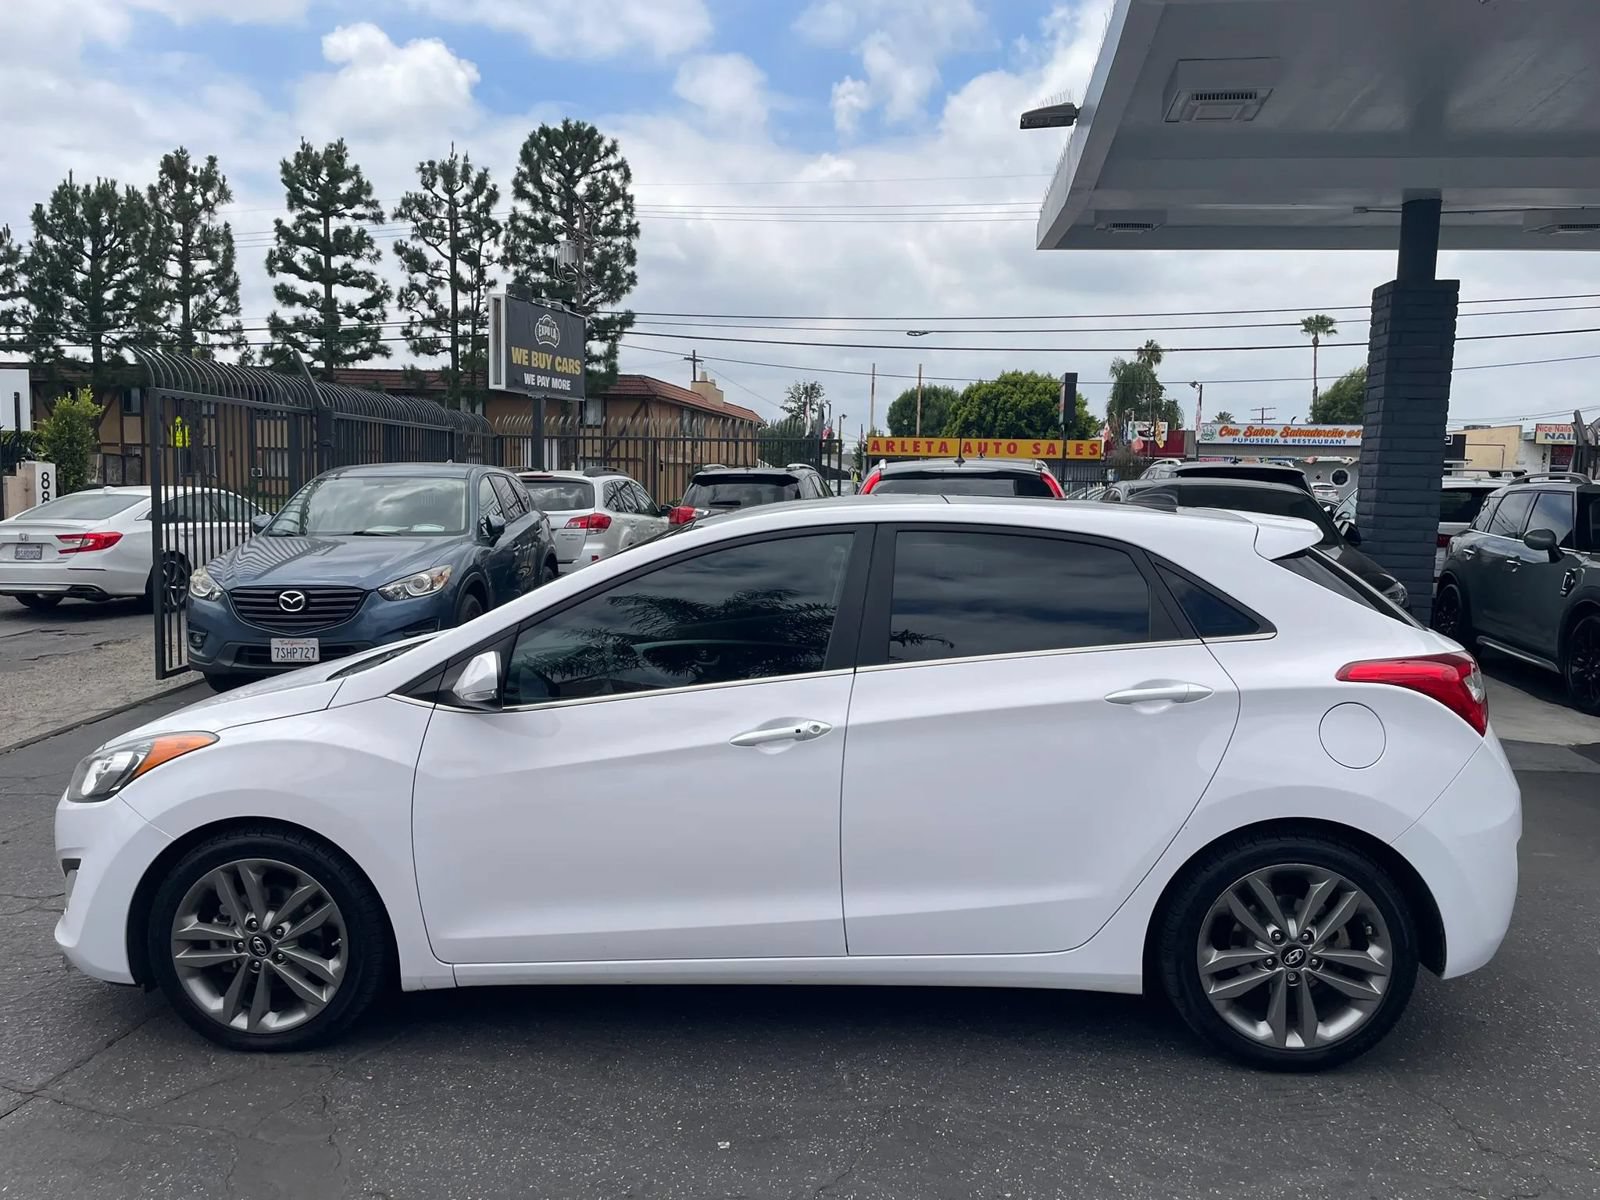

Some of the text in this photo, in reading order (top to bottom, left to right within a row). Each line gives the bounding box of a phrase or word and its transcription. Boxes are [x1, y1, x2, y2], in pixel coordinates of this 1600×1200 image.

[511, 346, 581, 375] WE BUY CARS
[524, 373, 571, 391] WE PAY MORE
[1219, 425, 1241, 438] Con
[1243, 425, 1276, 438] Sabor
[1280, 426, 1346, 439] Salvadoreño
[870, 440, 1098, 456] ARLETA AUTO SAES
[274, 647, 316, 658] 7SHP727
